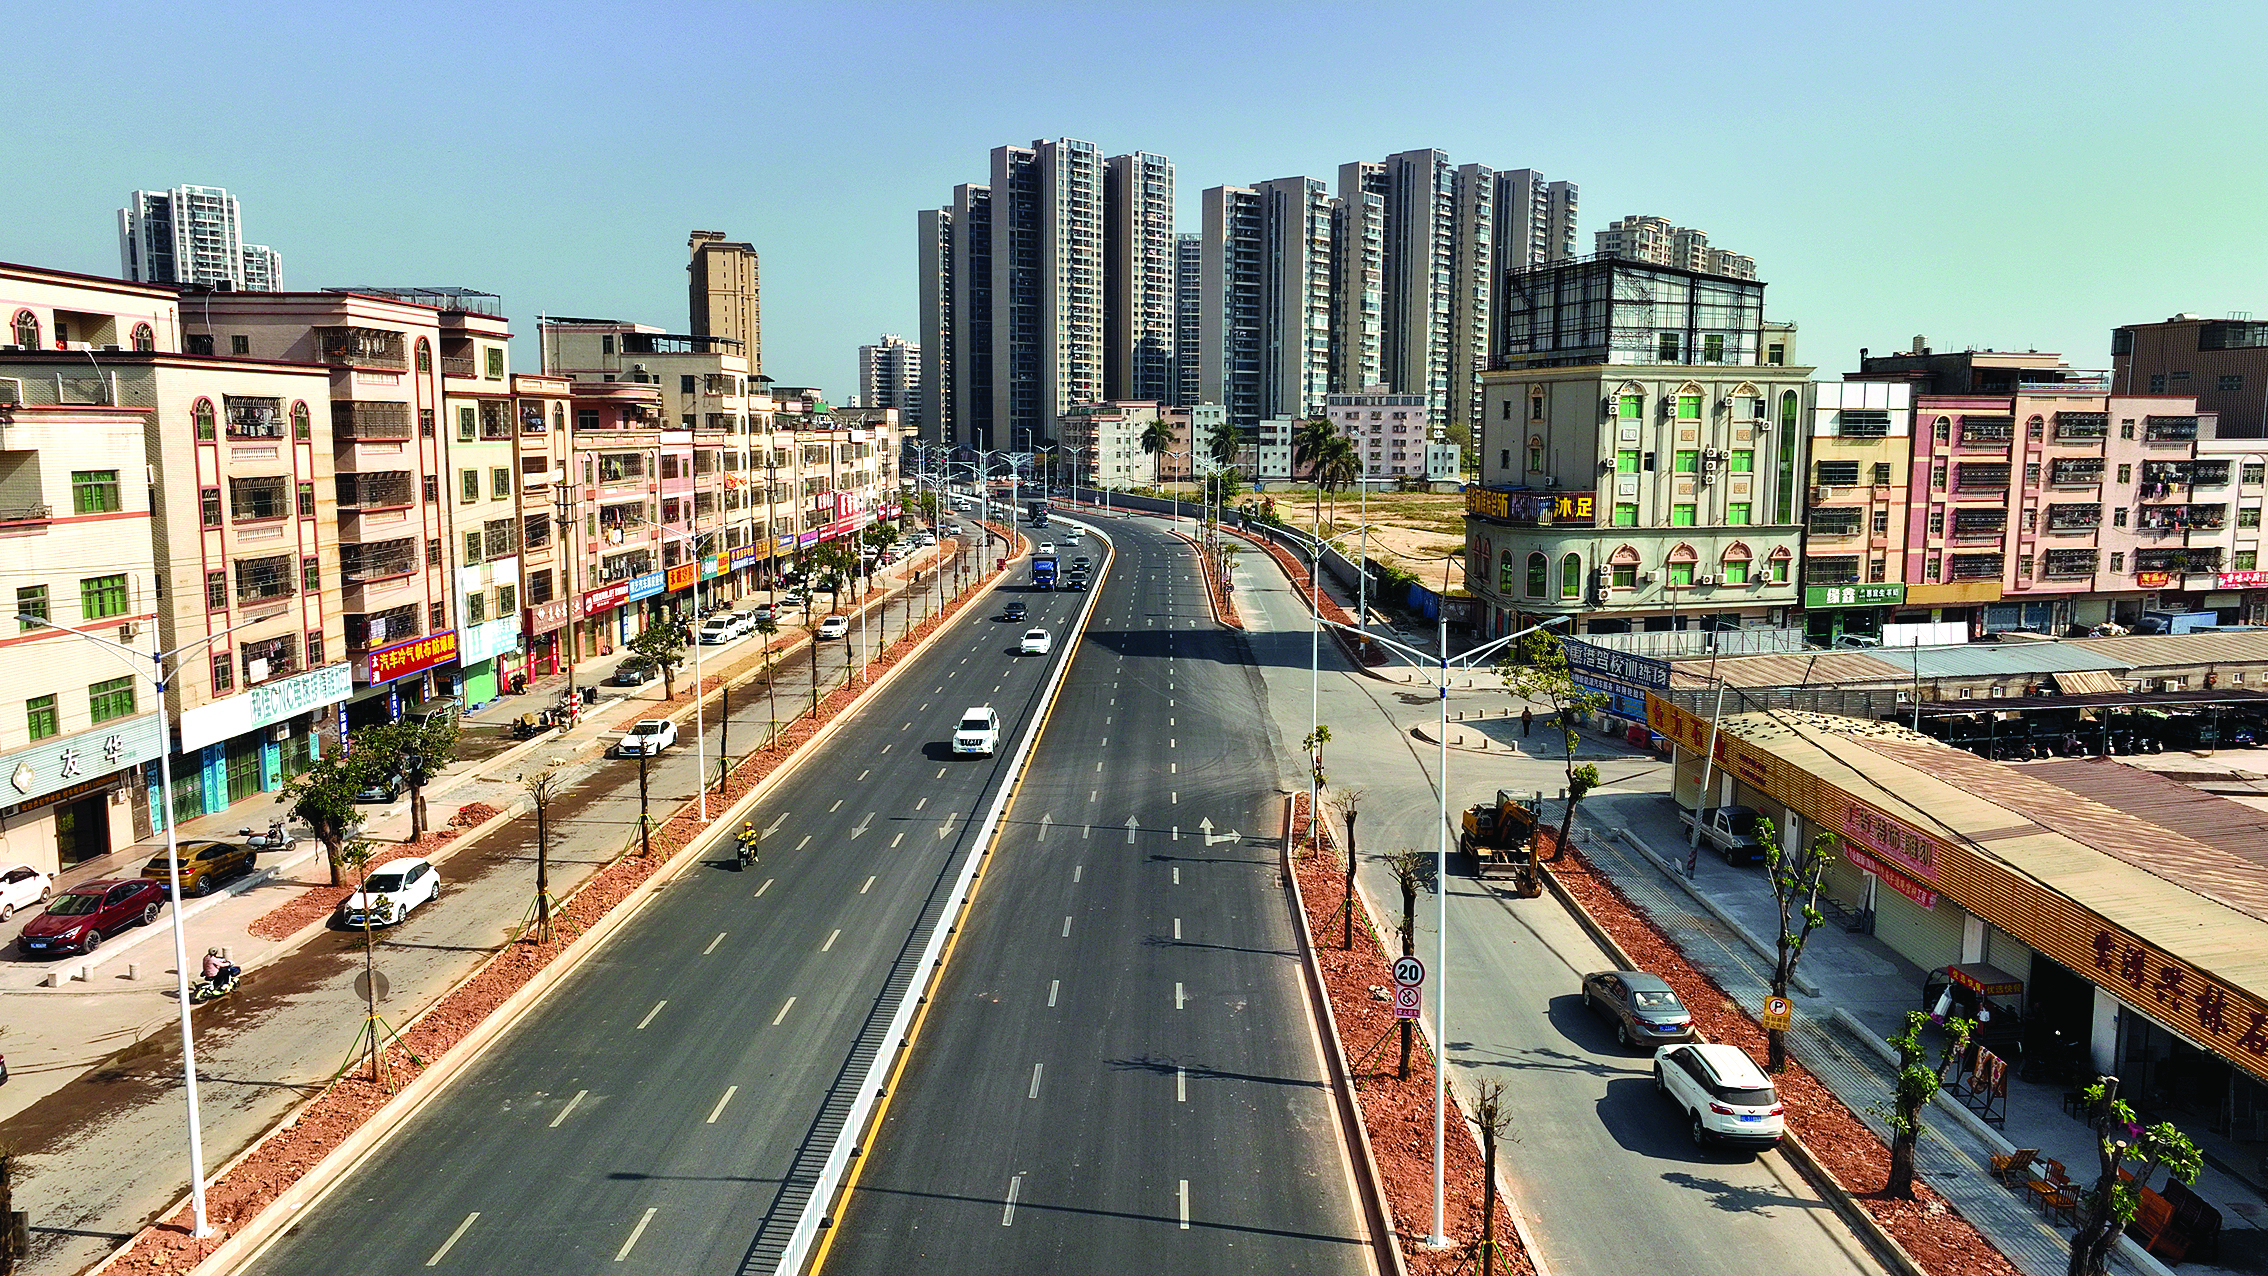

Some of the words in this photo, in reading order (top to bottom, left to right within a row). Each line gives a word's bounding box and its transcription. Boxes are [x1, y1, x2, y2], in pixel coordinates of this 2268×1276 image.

[1553, 497, 1593, 518] 沐足
[1569, 645, 1667, 686] 惠港驾校训练场
[60, 735, 125, 779] 友华
[1847, 802, 1933, 867] 广告装饰雕刻
[1397, 963, 1419, 981] 20
[1986, 983, 2022, 994] 优选快餐
